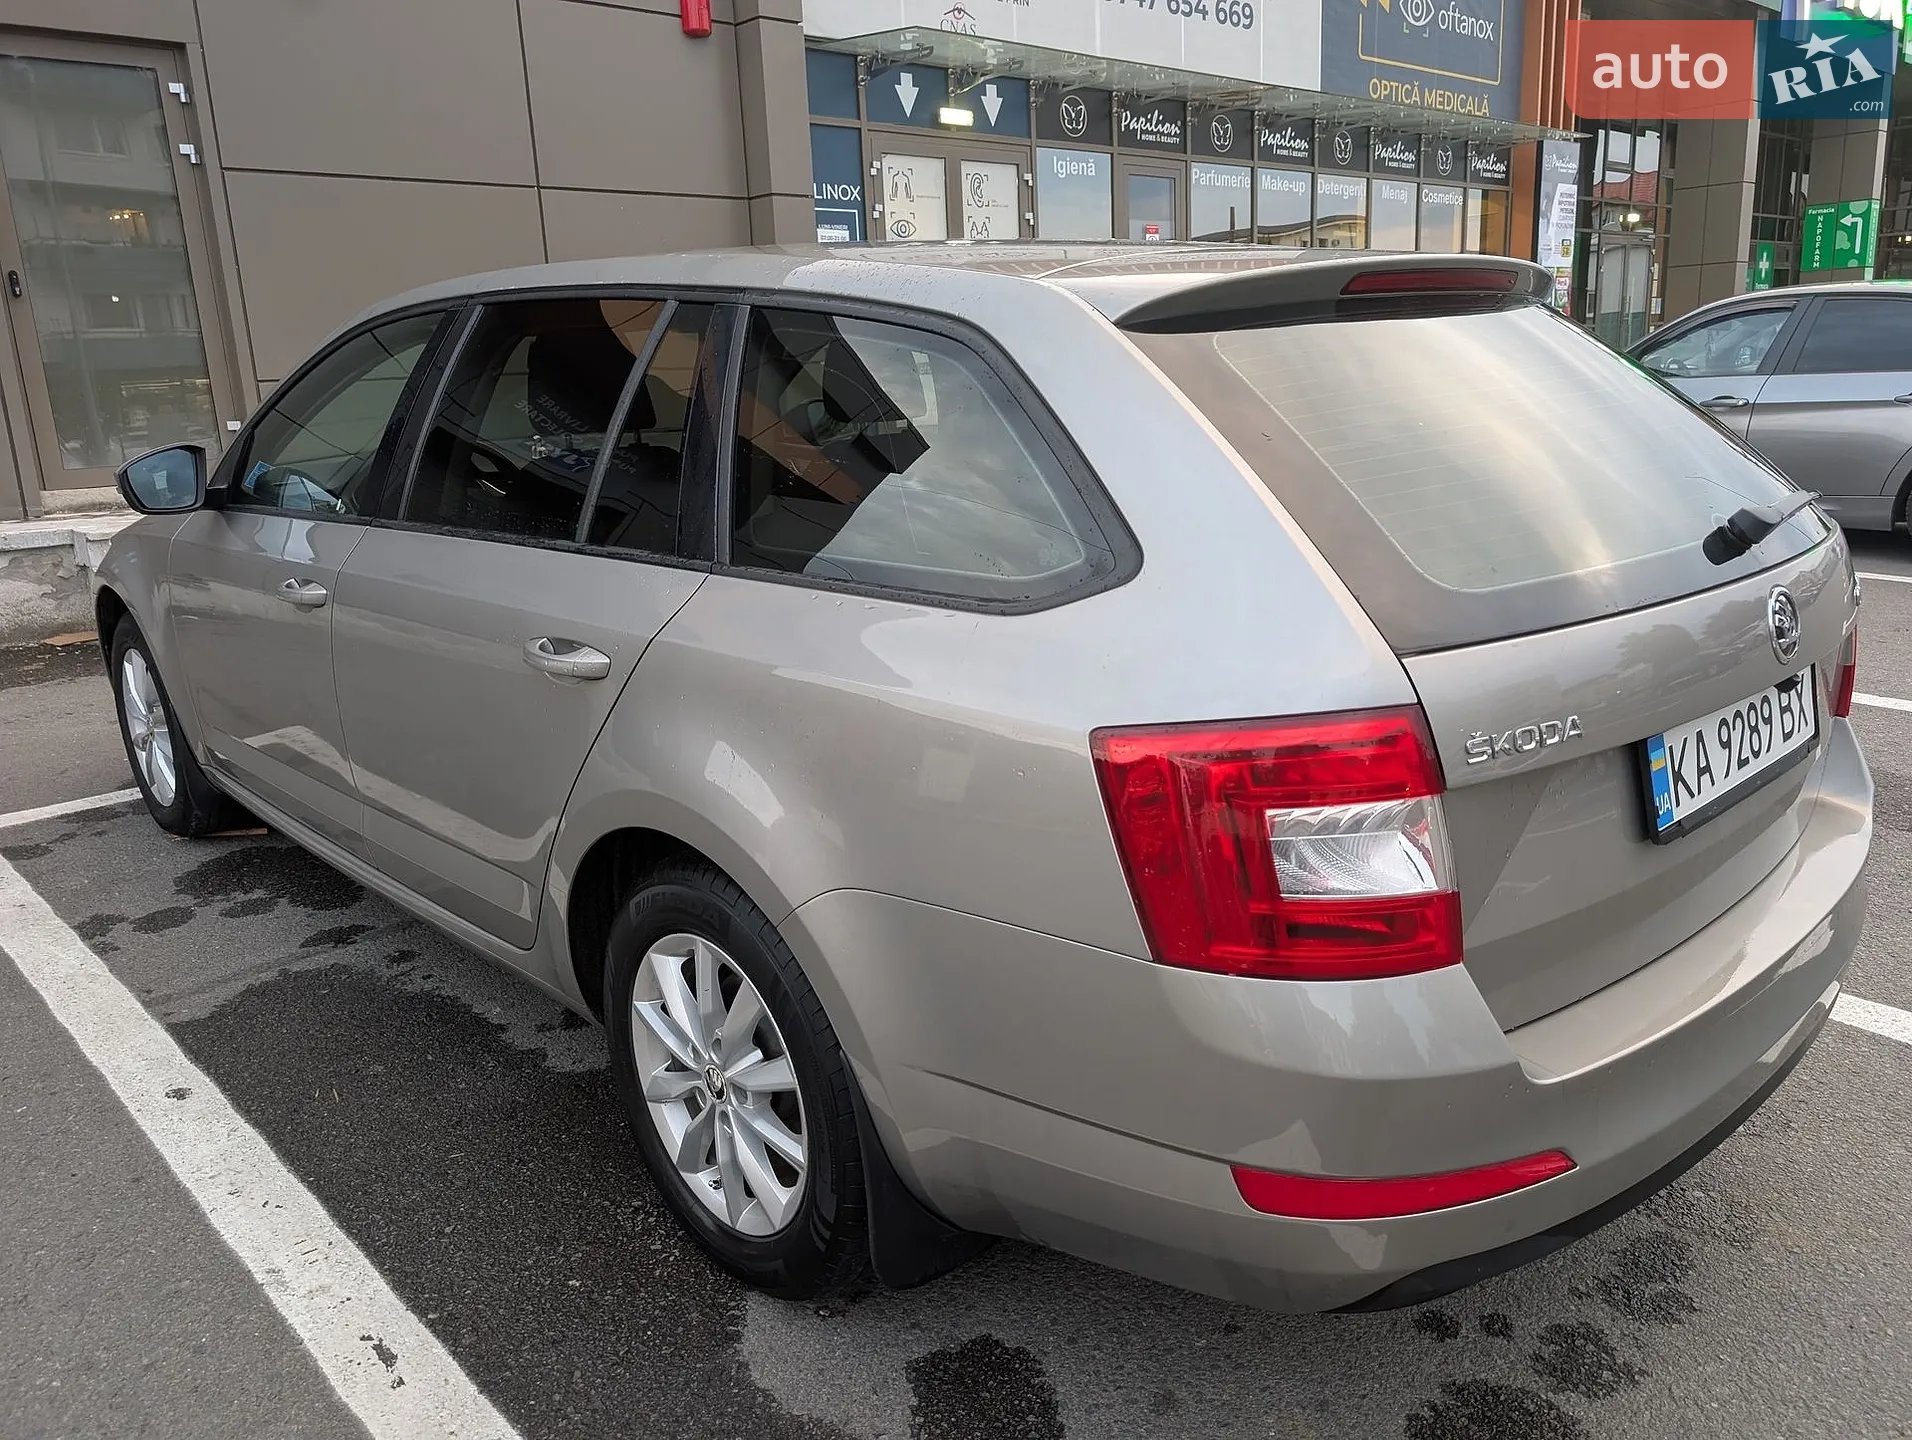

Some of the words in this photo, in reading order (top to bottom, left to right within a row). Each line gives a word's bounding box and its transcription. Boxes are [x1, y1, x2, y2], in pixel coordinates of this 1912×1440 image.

[1166, 0, 1209, 21] 654
[1214, 0, 1254, 30] 669
[1438, 1, 1494, 41] oftanox
[940, 18, 977, 37] CNAS
[1369, 78, 1421, 106] OPTICĂ
[1424, 87, 1490, 117] MEDICALĂ
[1141, 134, 1156, 142] HOME
[1161, 136, 1180, 144] BEAUTY
[1053, 156, 1096, 178] Igienă
[1192, 168, 1251, 189] Parfumerie
[1261, 174, 1306, 196] Make-up
[813, 182, 861, 201] LINOX
[1382, 185, 1408, 203] Menaj
[1422, 189, 1464, 206] Cosmetice
[1808, 207, 1835, 215] Farmacia
[1812, 215, 1824, 268] NAPOFARM
[1465, 715, 1583, 765] ŠKODA
[1668, 729, 1716, 808] KA
[1717, 694, 1773, 781] 9289
[1777, 672, 1809, 743] BX
[1656, 792, 1672, 815] UA
